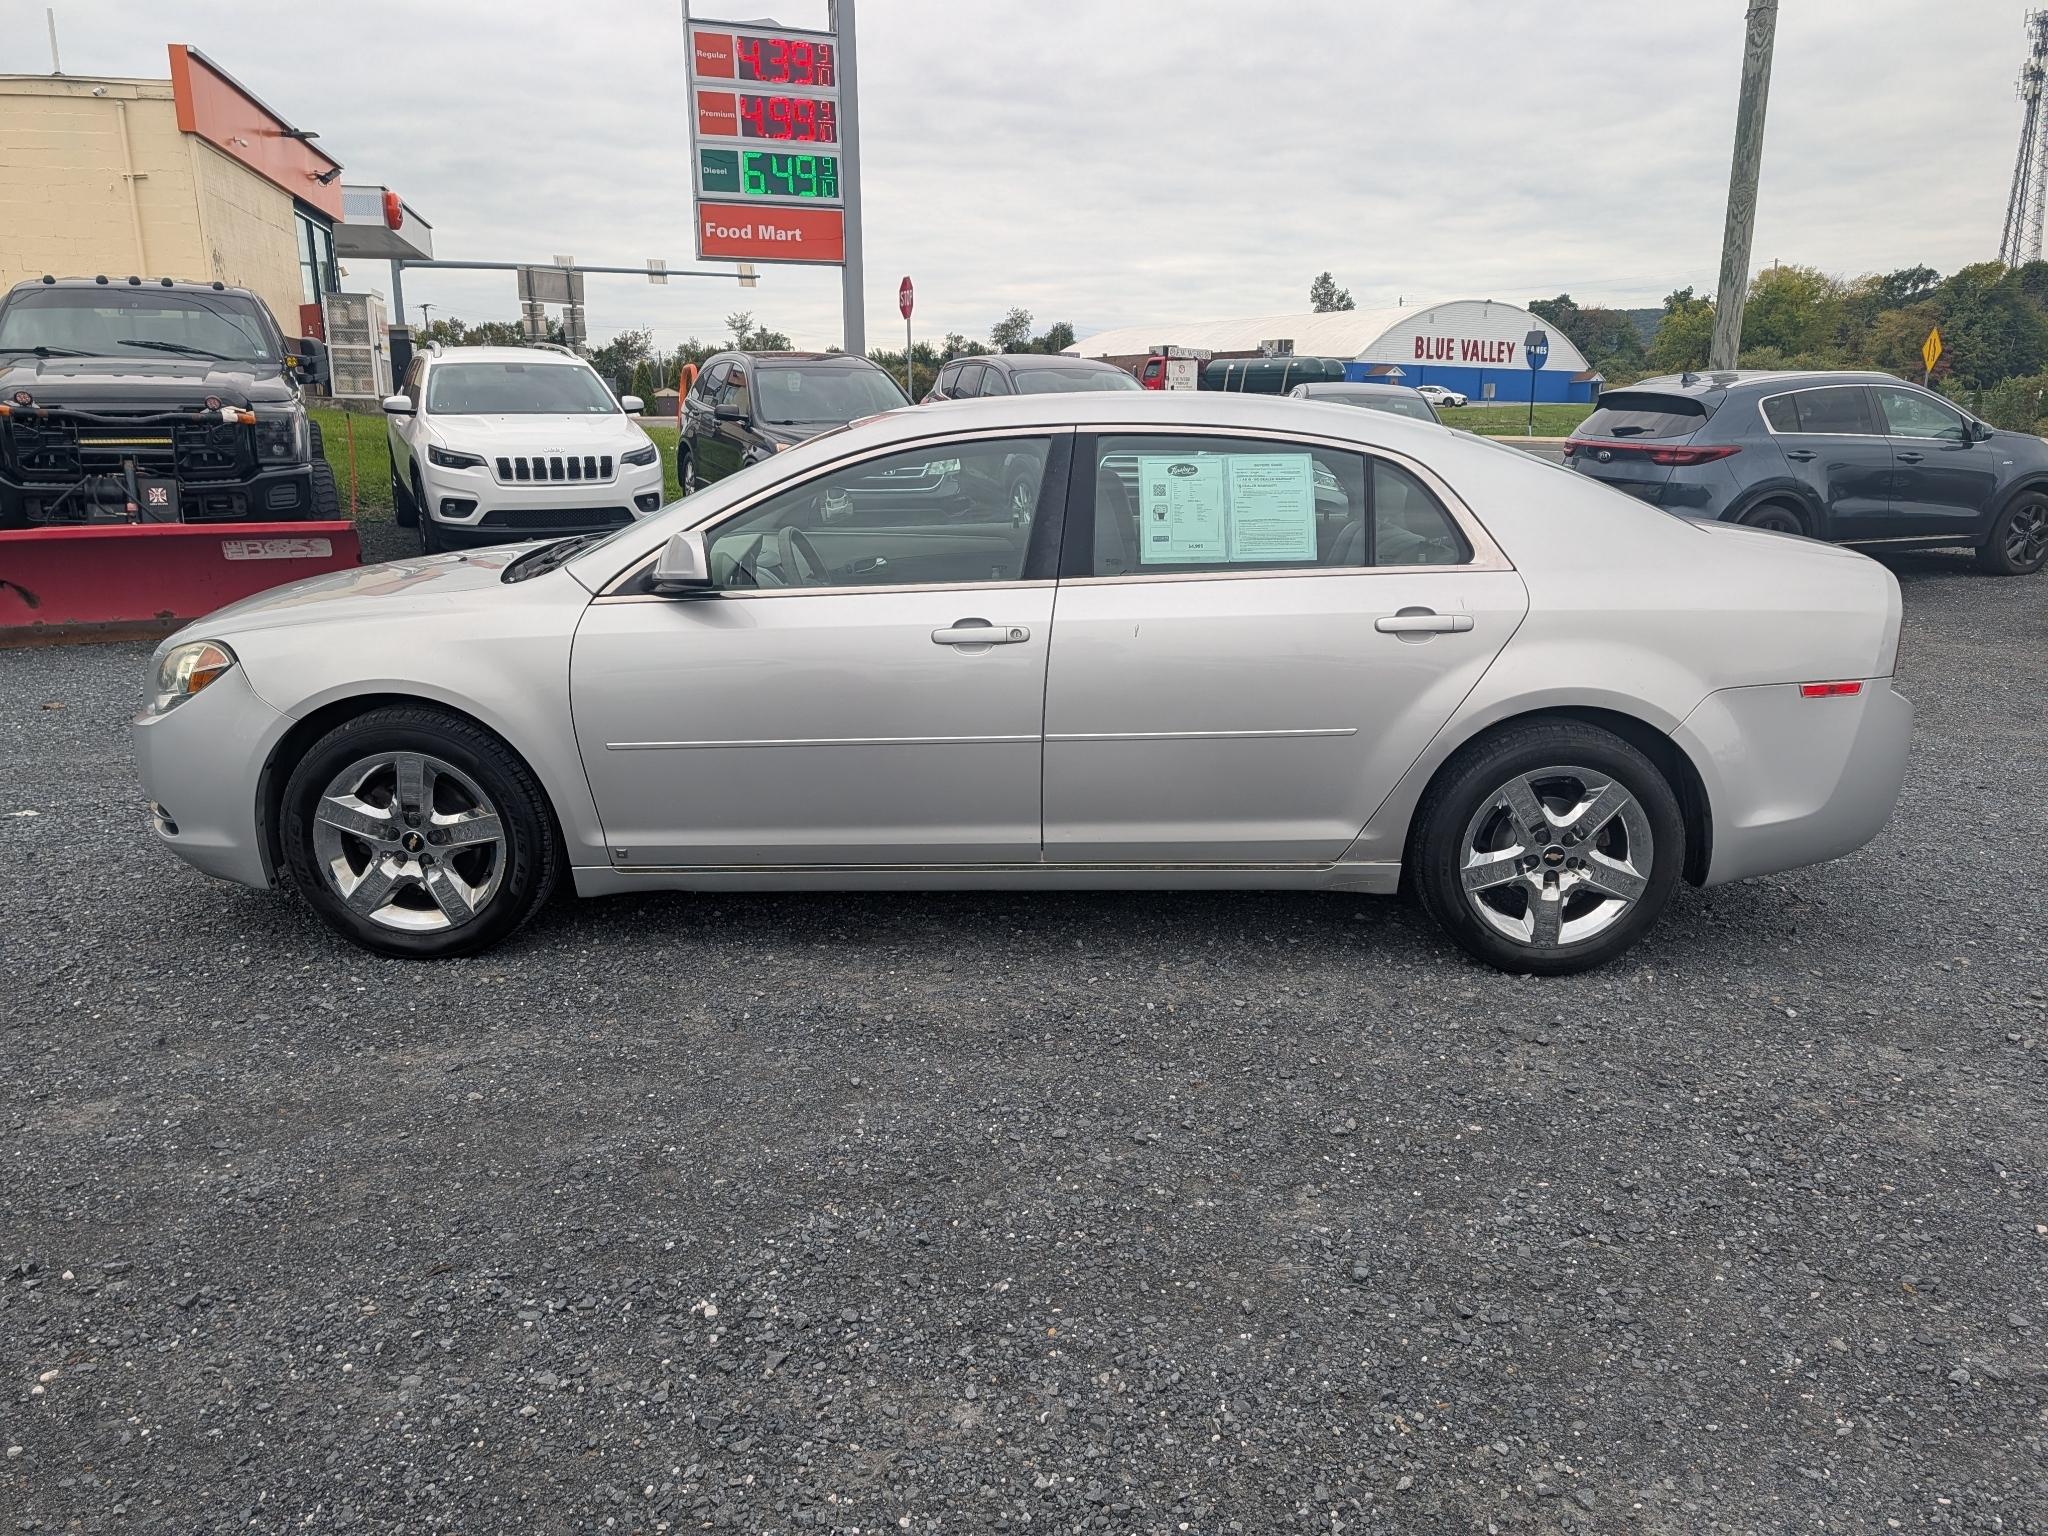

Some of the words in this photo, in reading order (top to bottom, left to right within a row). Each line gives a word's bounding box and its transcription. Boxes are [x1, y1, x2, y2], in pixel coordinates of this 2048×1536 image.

[696, 49, 728, 60] Regular
[737, 38, 813, 86] 4.39
[700, 109, 736, 119] Premium
[740, 95, 816, 143] 4.99
[703, 166, 728, 176] Diesel
[742, 151, 818, 198] 6.49
[705, 222, 752, 240] Food
[758, 224, 802, 242] Mart
[1414, 335, 1455, 361] BLUE
[1461, 338, 1516, 364] VALLEY
